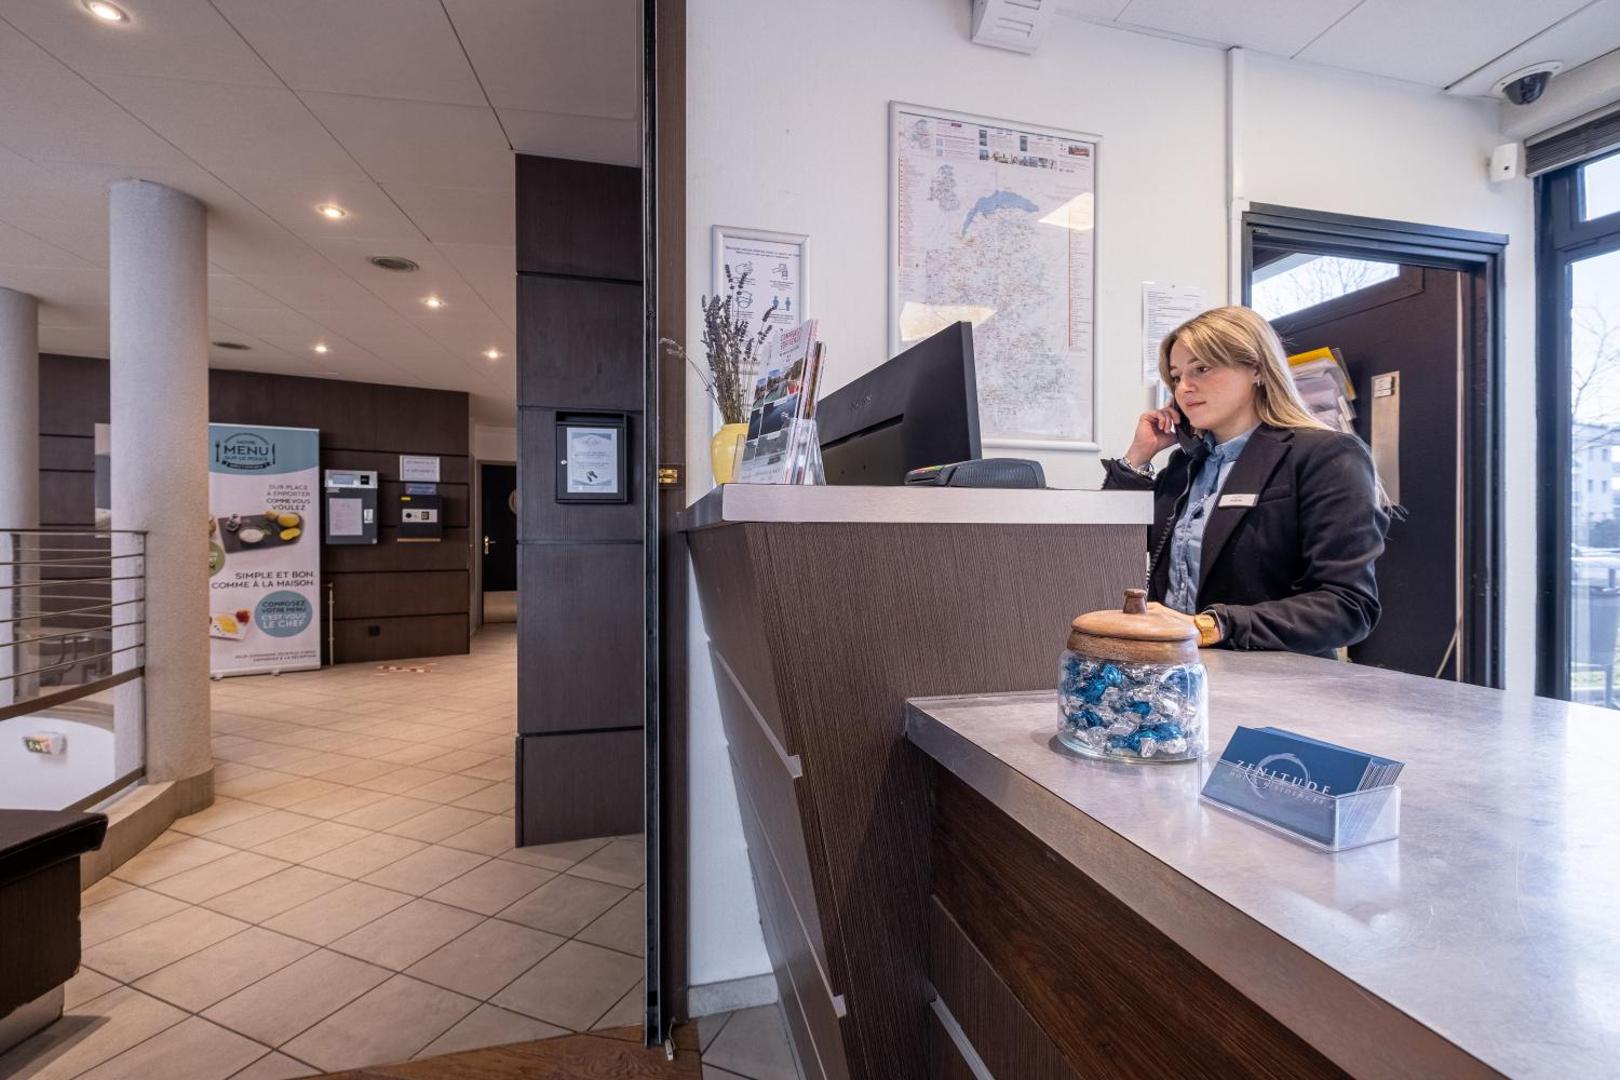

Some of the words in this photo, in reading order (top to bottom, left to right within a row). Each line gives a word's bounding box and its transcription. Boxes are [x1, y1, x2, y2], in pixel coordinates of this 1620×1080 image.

[223, 445, 269, 456] MENU
[235, 571, 273, 580] SIMPLE
[276, 571, 288, 579] ET
[211, 581, 250, 590] COMME
[277, 579, 314, 587] MAISON
[262, 600, 305, 608] COMPOSEZ
[263, 620, 275, 629] LE
[278, 619, 305, 628] CHEF
[1235, 759, 1332, 795] ZENITUDE
